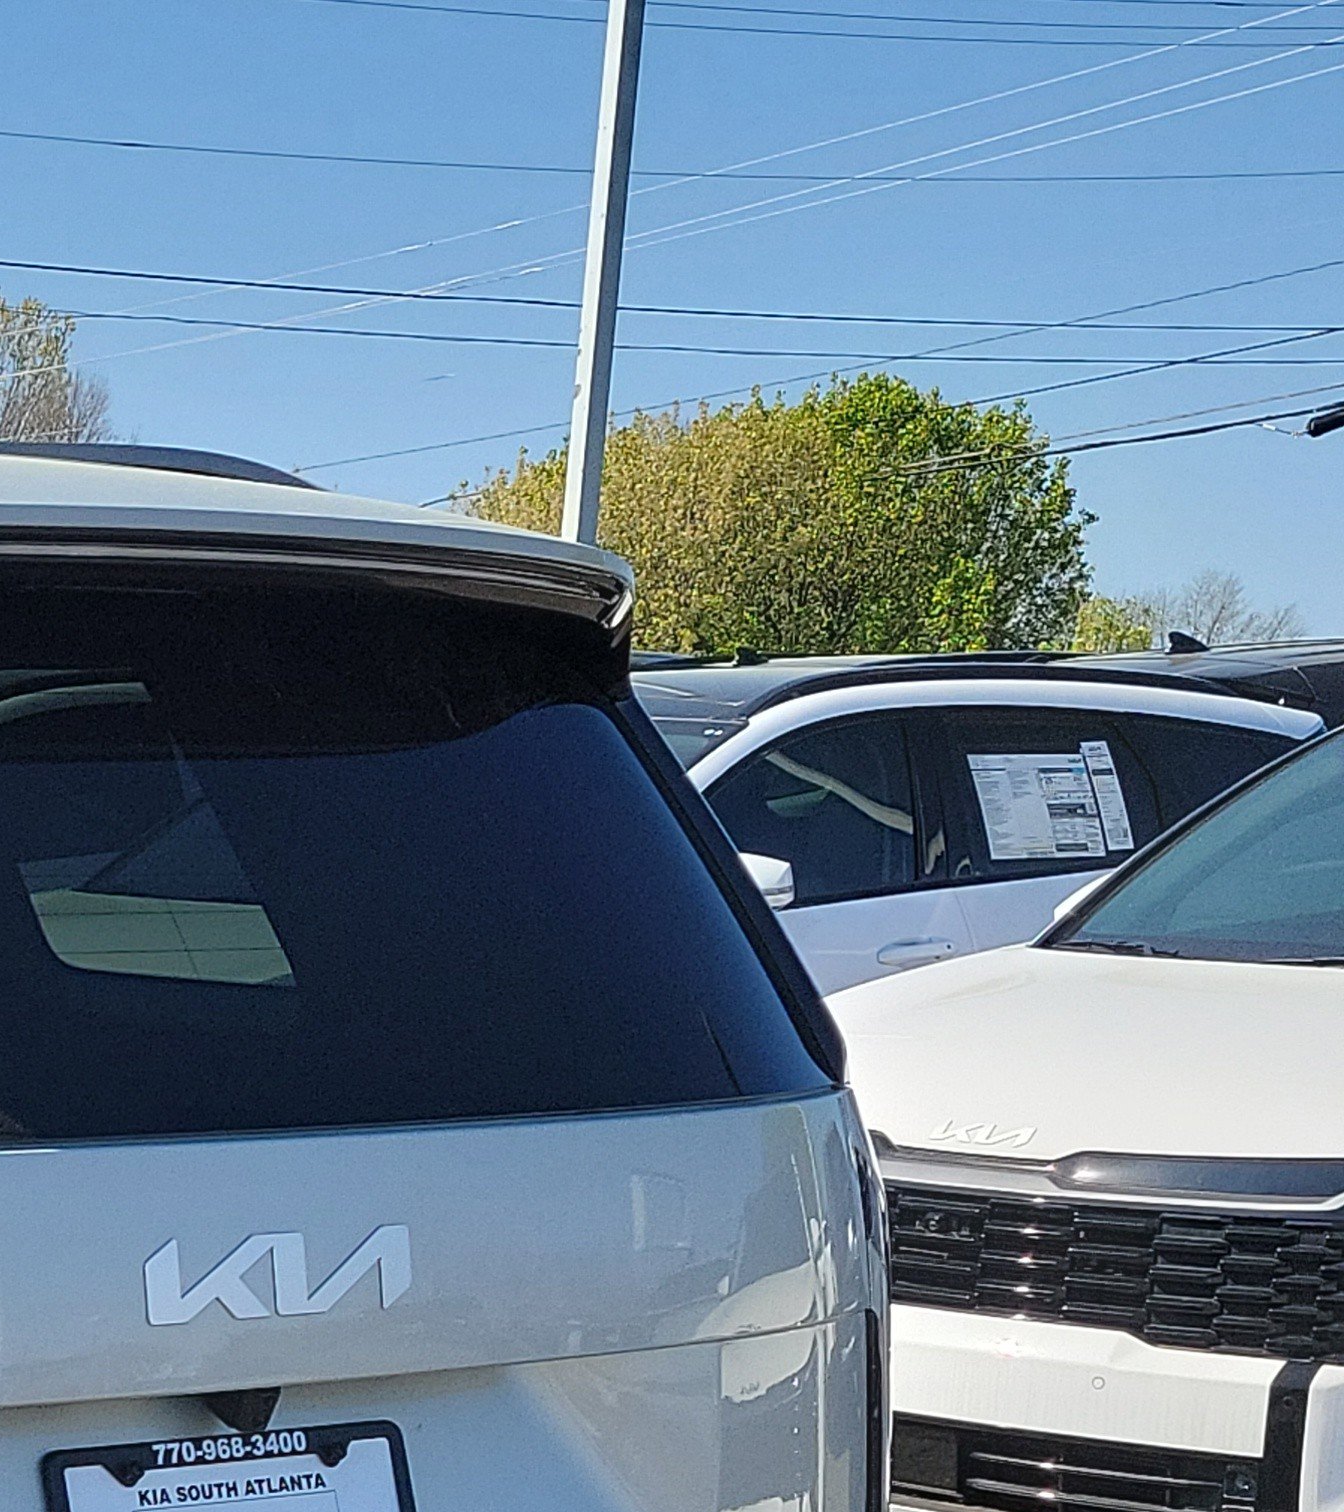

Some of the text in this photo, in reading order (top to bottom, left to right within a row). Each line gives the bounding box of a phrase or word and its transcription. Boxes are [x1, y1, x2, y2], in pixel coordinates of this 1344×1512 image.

[143, 1223, 413, 1326] KIA
[152, 1431, 307, 1466] 770-968-3400
[137, 1472, 327, 1507] KIA SOUTH ATLANTA
